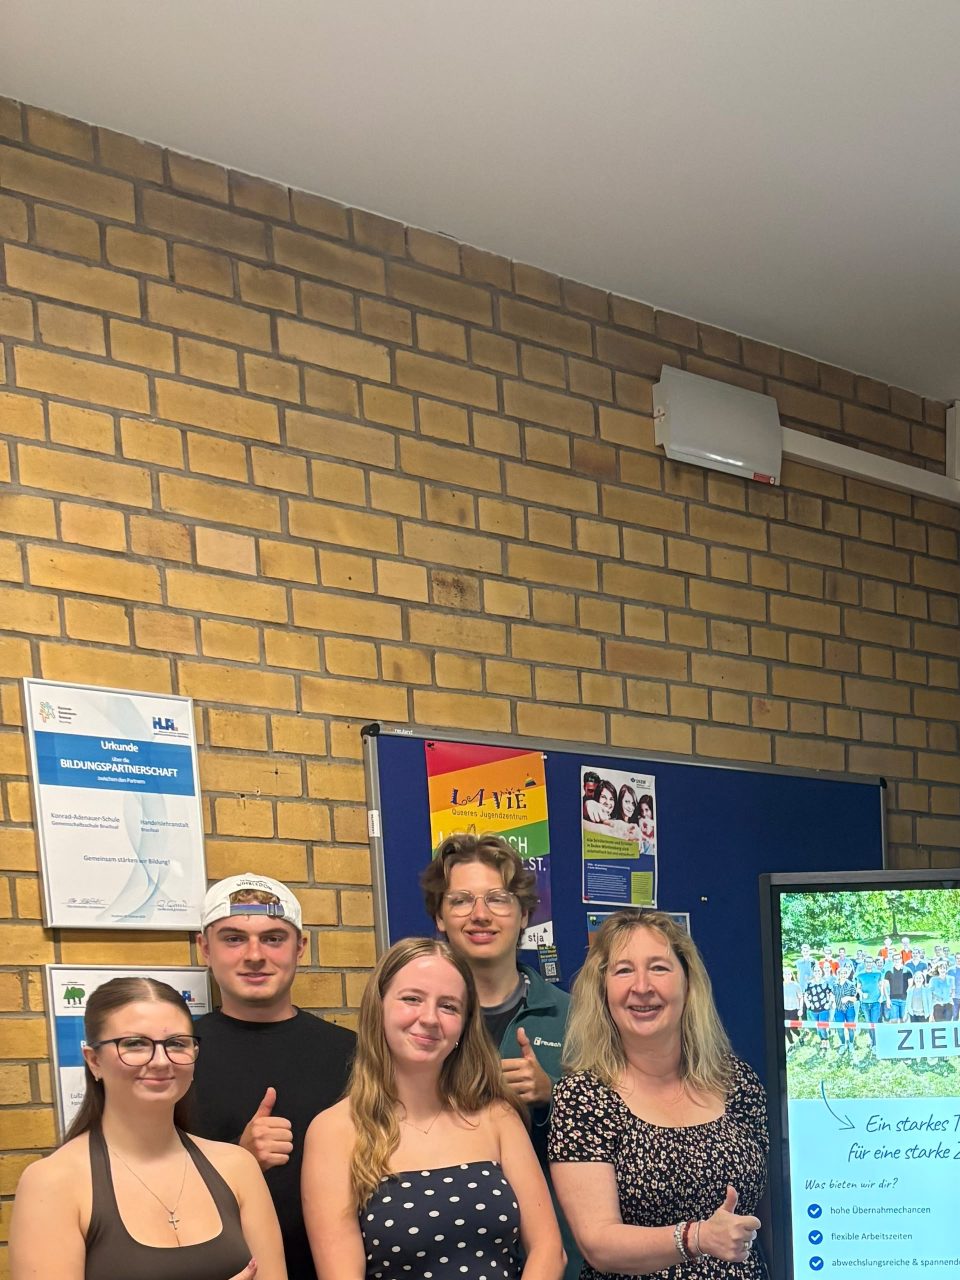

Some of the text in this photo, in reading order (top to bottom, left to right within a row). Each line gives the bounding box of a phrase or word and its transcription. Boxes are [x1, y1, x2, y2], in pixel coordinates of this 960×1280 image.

[100, 740, 139, 753] Urkunde
[60, 758, 179, 778] BILDUNGSPARTNERSCHAFT
[50, 812, 120, 823] Konrad-Adenauer-Schule
[451, 808, 528, 821] Queeres Jugendzentrum
[866, 1114, 891, 1132] Ein
[896, 1113, 949, 1132] starkes
[848, 1142, 869, 1162] für
[873, 1145, 901, 1160] eine
[904, 1142, 950, 1159] starke
[805, 1177, 899, 1190] Was bieten wir dir?
[830, 1204, 931, 1215] hohe Übernahmechancen
[831, 1232, 913, 1241] flexible Arbeitszeiten
[832, 1258, 910, 1268] abwechslungsreiche
[912, 1258, 918, 1266] &
